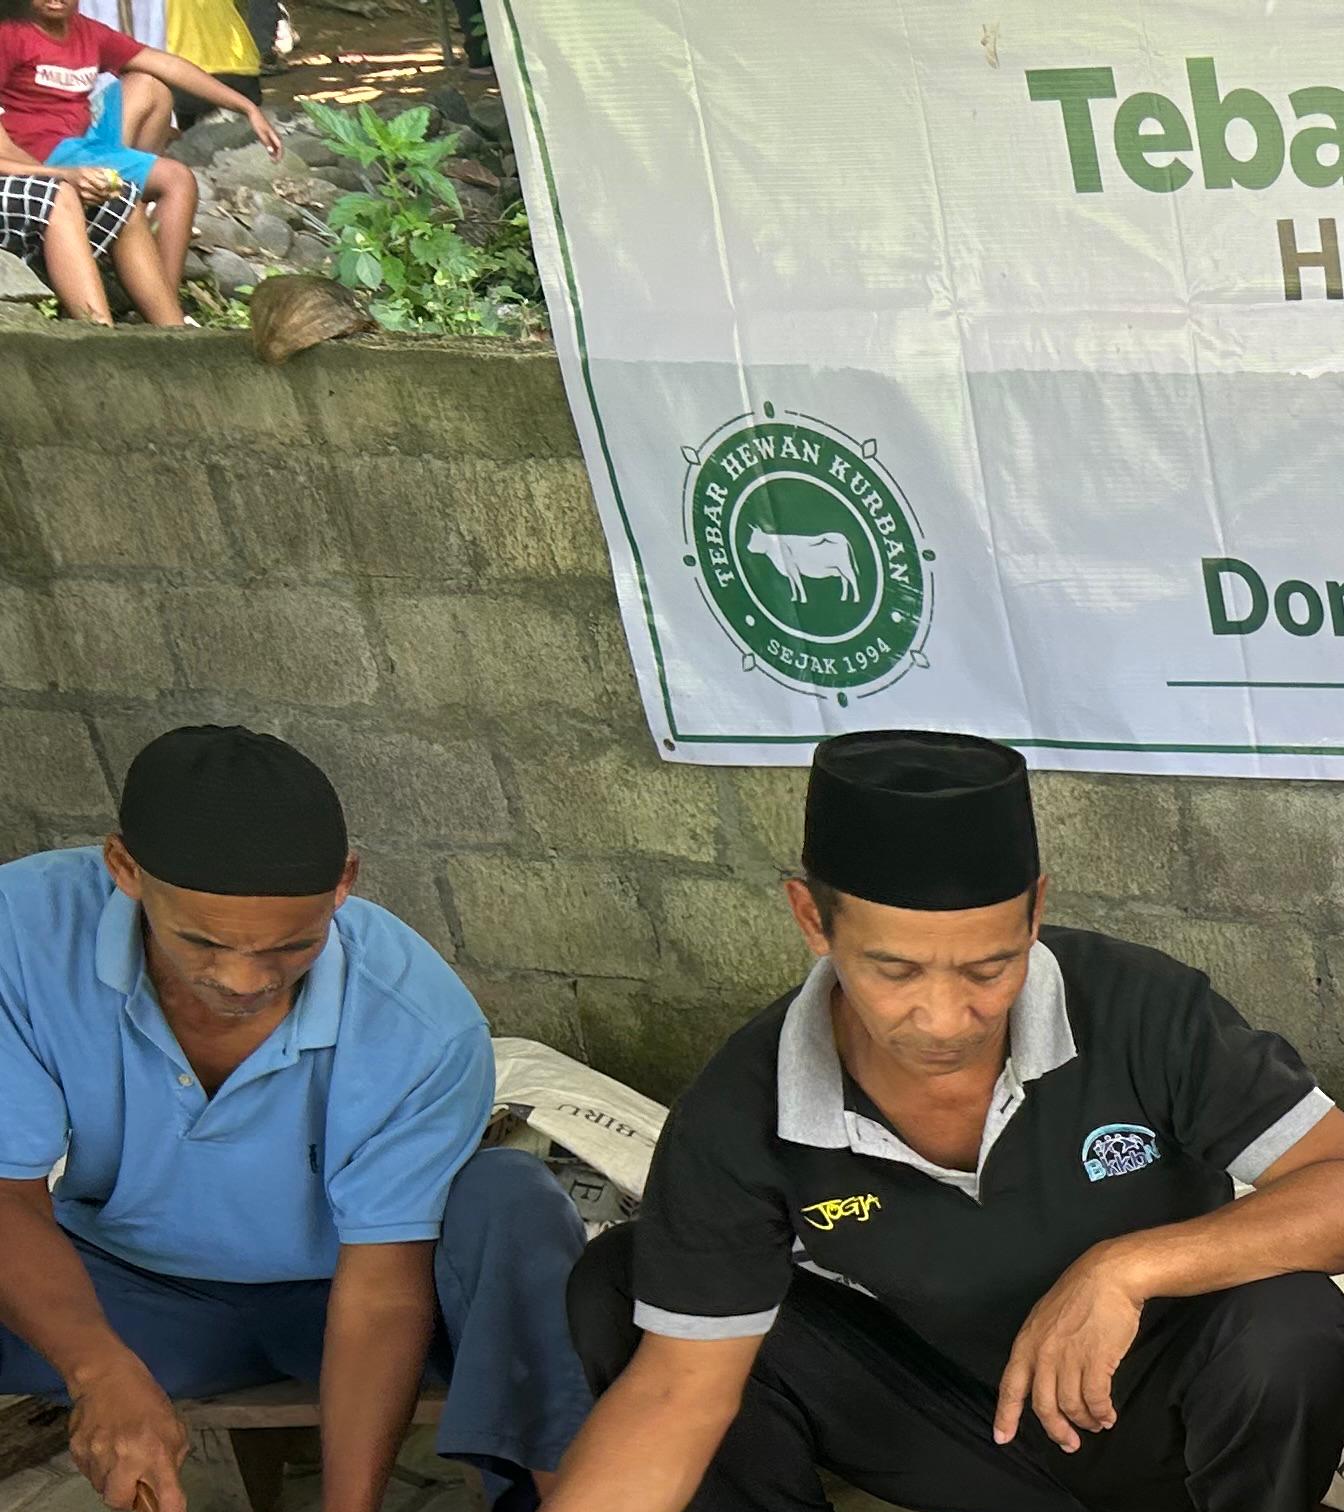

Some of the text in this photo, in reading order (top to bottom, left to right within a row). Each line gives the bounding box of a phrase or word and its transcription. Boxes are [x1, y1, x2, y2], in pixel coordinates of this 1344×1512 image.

[704, 435, 910, 588] TEBAR HEWAN KURBAN
[767, 637, 892, 675] SEJAK 1994
